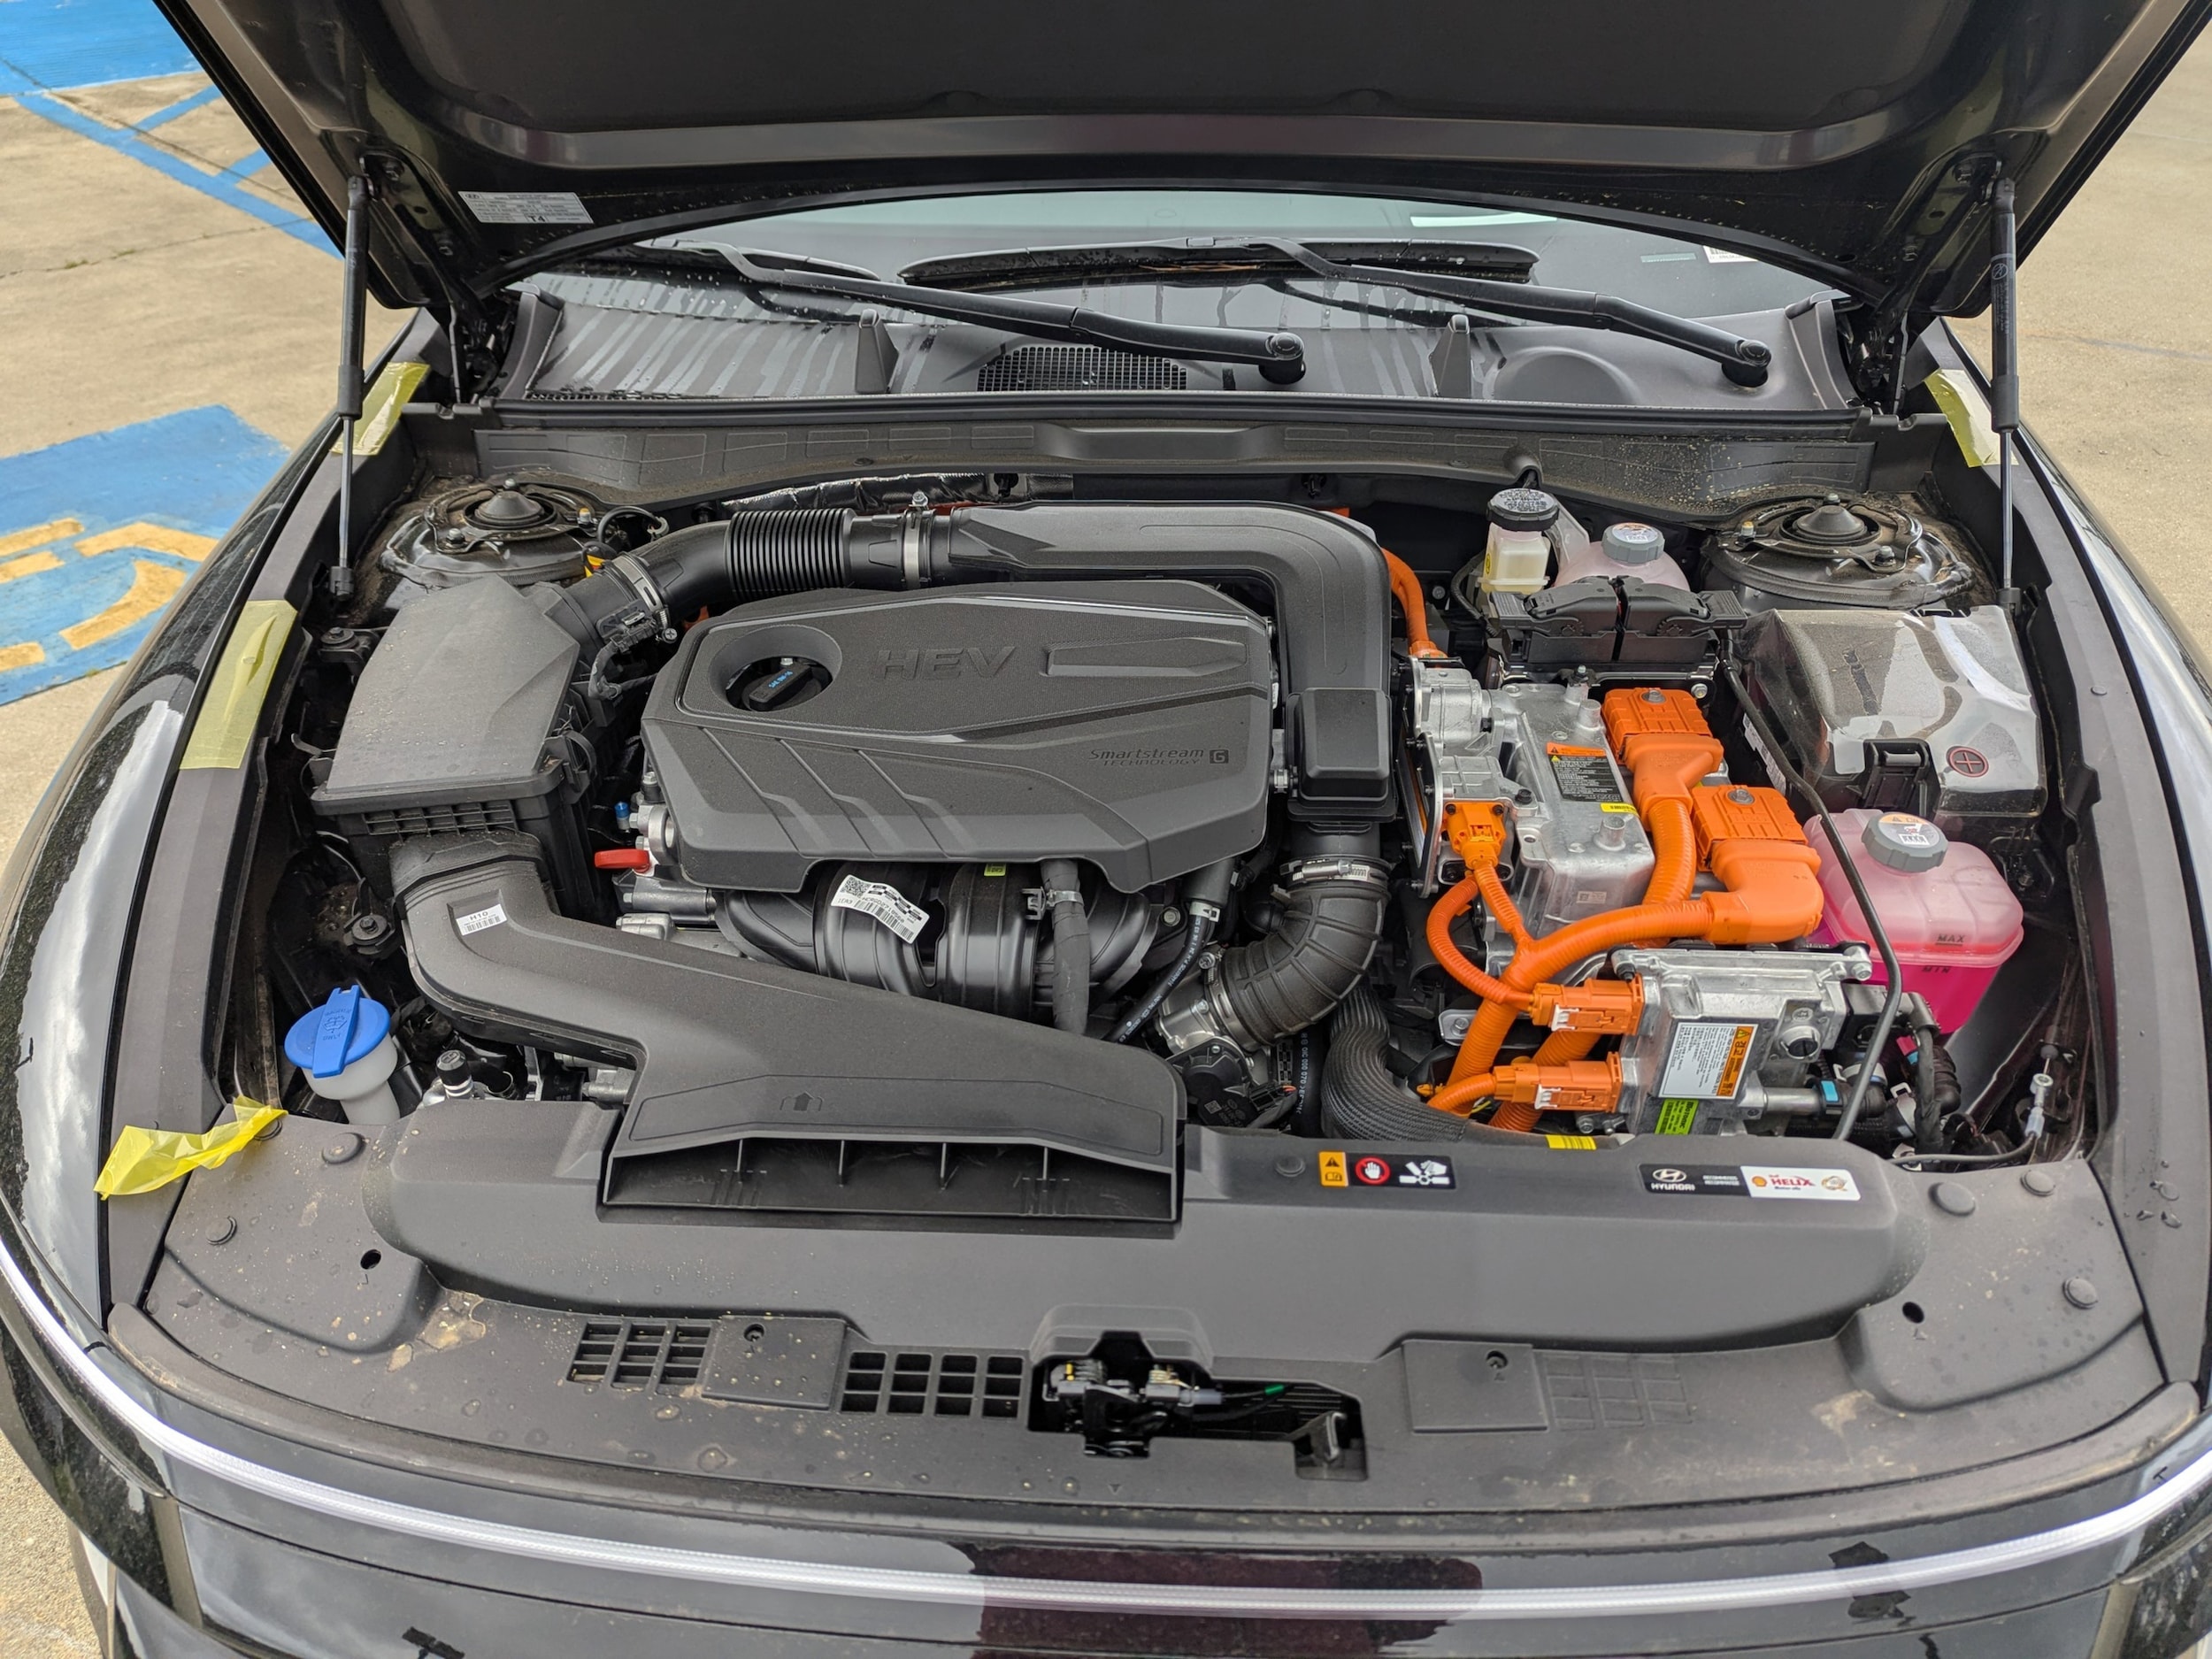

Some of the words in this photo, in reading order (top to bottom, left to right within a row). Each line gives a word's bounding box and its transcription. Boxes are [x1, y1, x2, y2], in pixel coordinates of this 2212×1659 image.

[872, 646, 1017, 680] HEV
[1089, 749, 1204, 760] Smartstream
[470, 910, 488, 921] H10
[1937, 933, 1965, 943] MAX
[1651, 1182, 1695, 1192] HYUNDAI
[1770, 1178, 1814, 1187] HELIX
